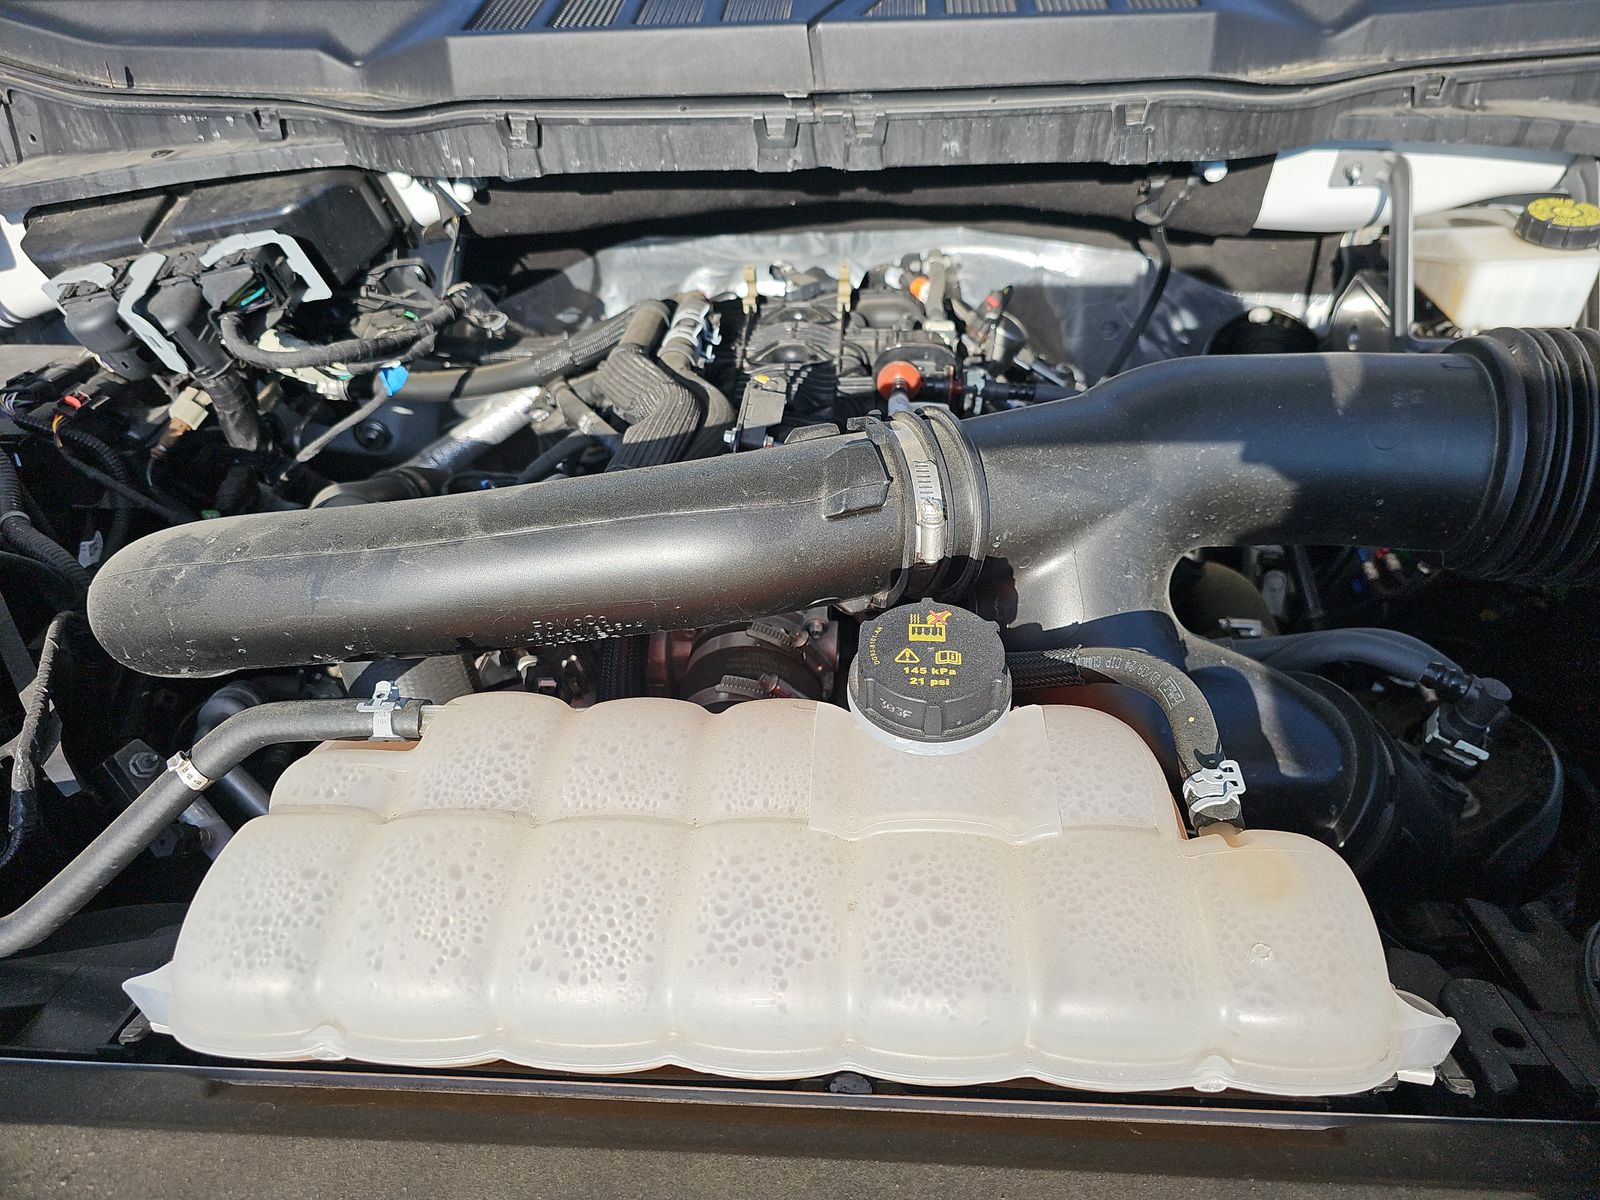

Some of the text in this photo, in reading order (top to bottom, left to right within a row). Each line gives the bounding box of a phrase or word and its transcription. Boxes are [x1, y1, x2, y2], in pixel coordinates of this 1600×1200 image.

[931, 667, 957, 676] kPa
[909, 677, 950, 687] 21 psi
